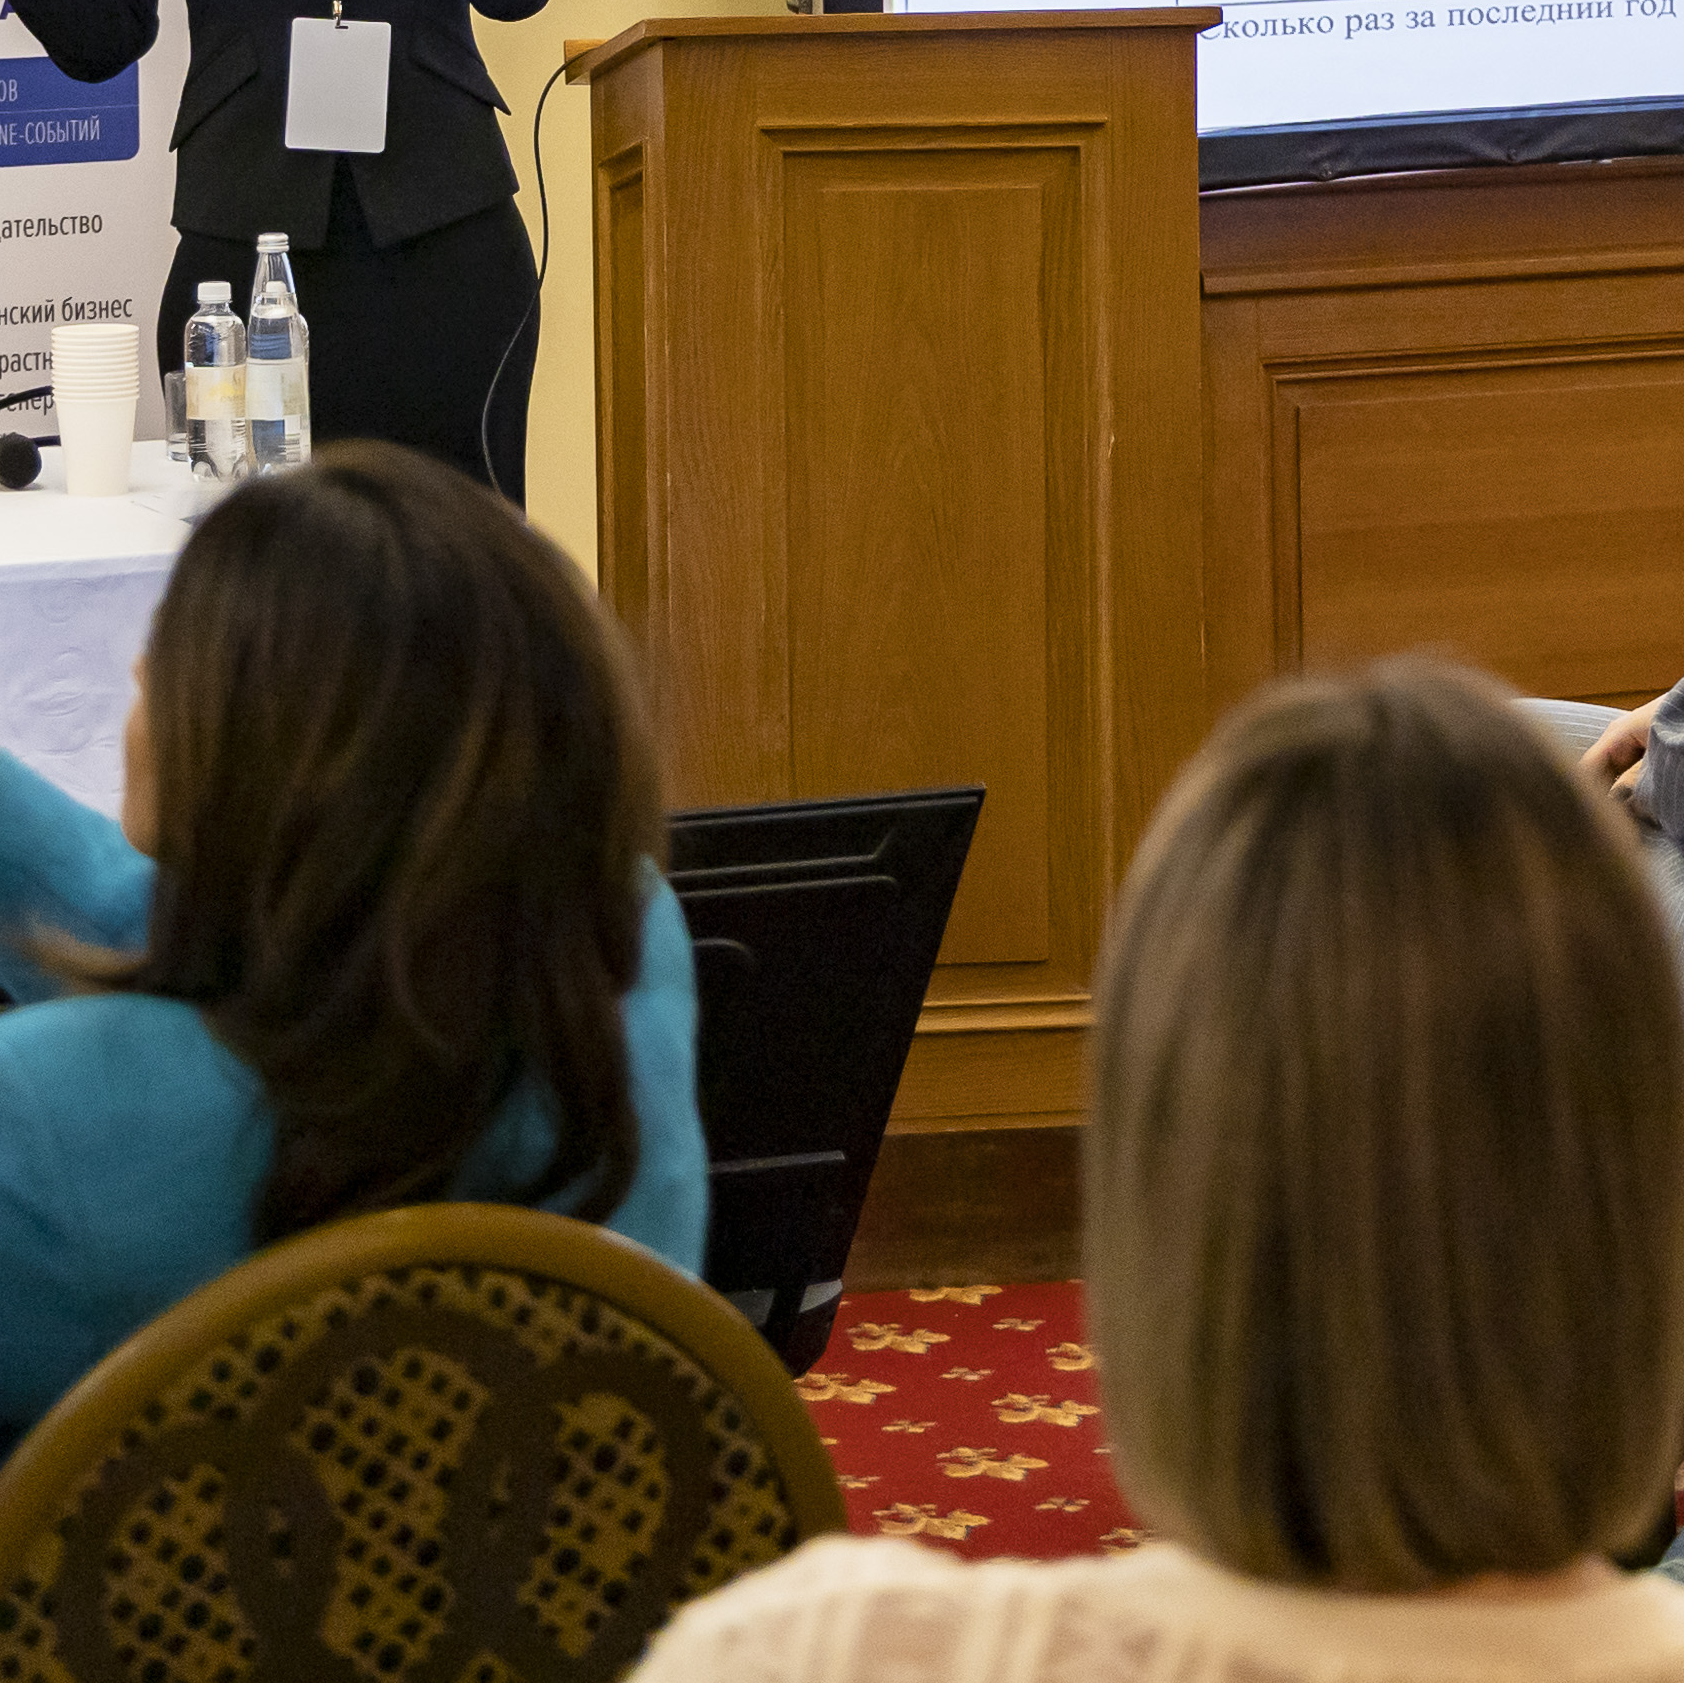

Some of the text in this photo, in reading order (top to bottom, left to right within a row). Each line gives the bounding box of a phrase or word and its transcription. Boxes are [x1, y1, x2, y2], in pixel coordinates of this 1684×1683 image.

[1344, 12, 1395, 40] раз
[1405, 9, 1436, 30] за
[61, 296, 133, 322] бизнес
